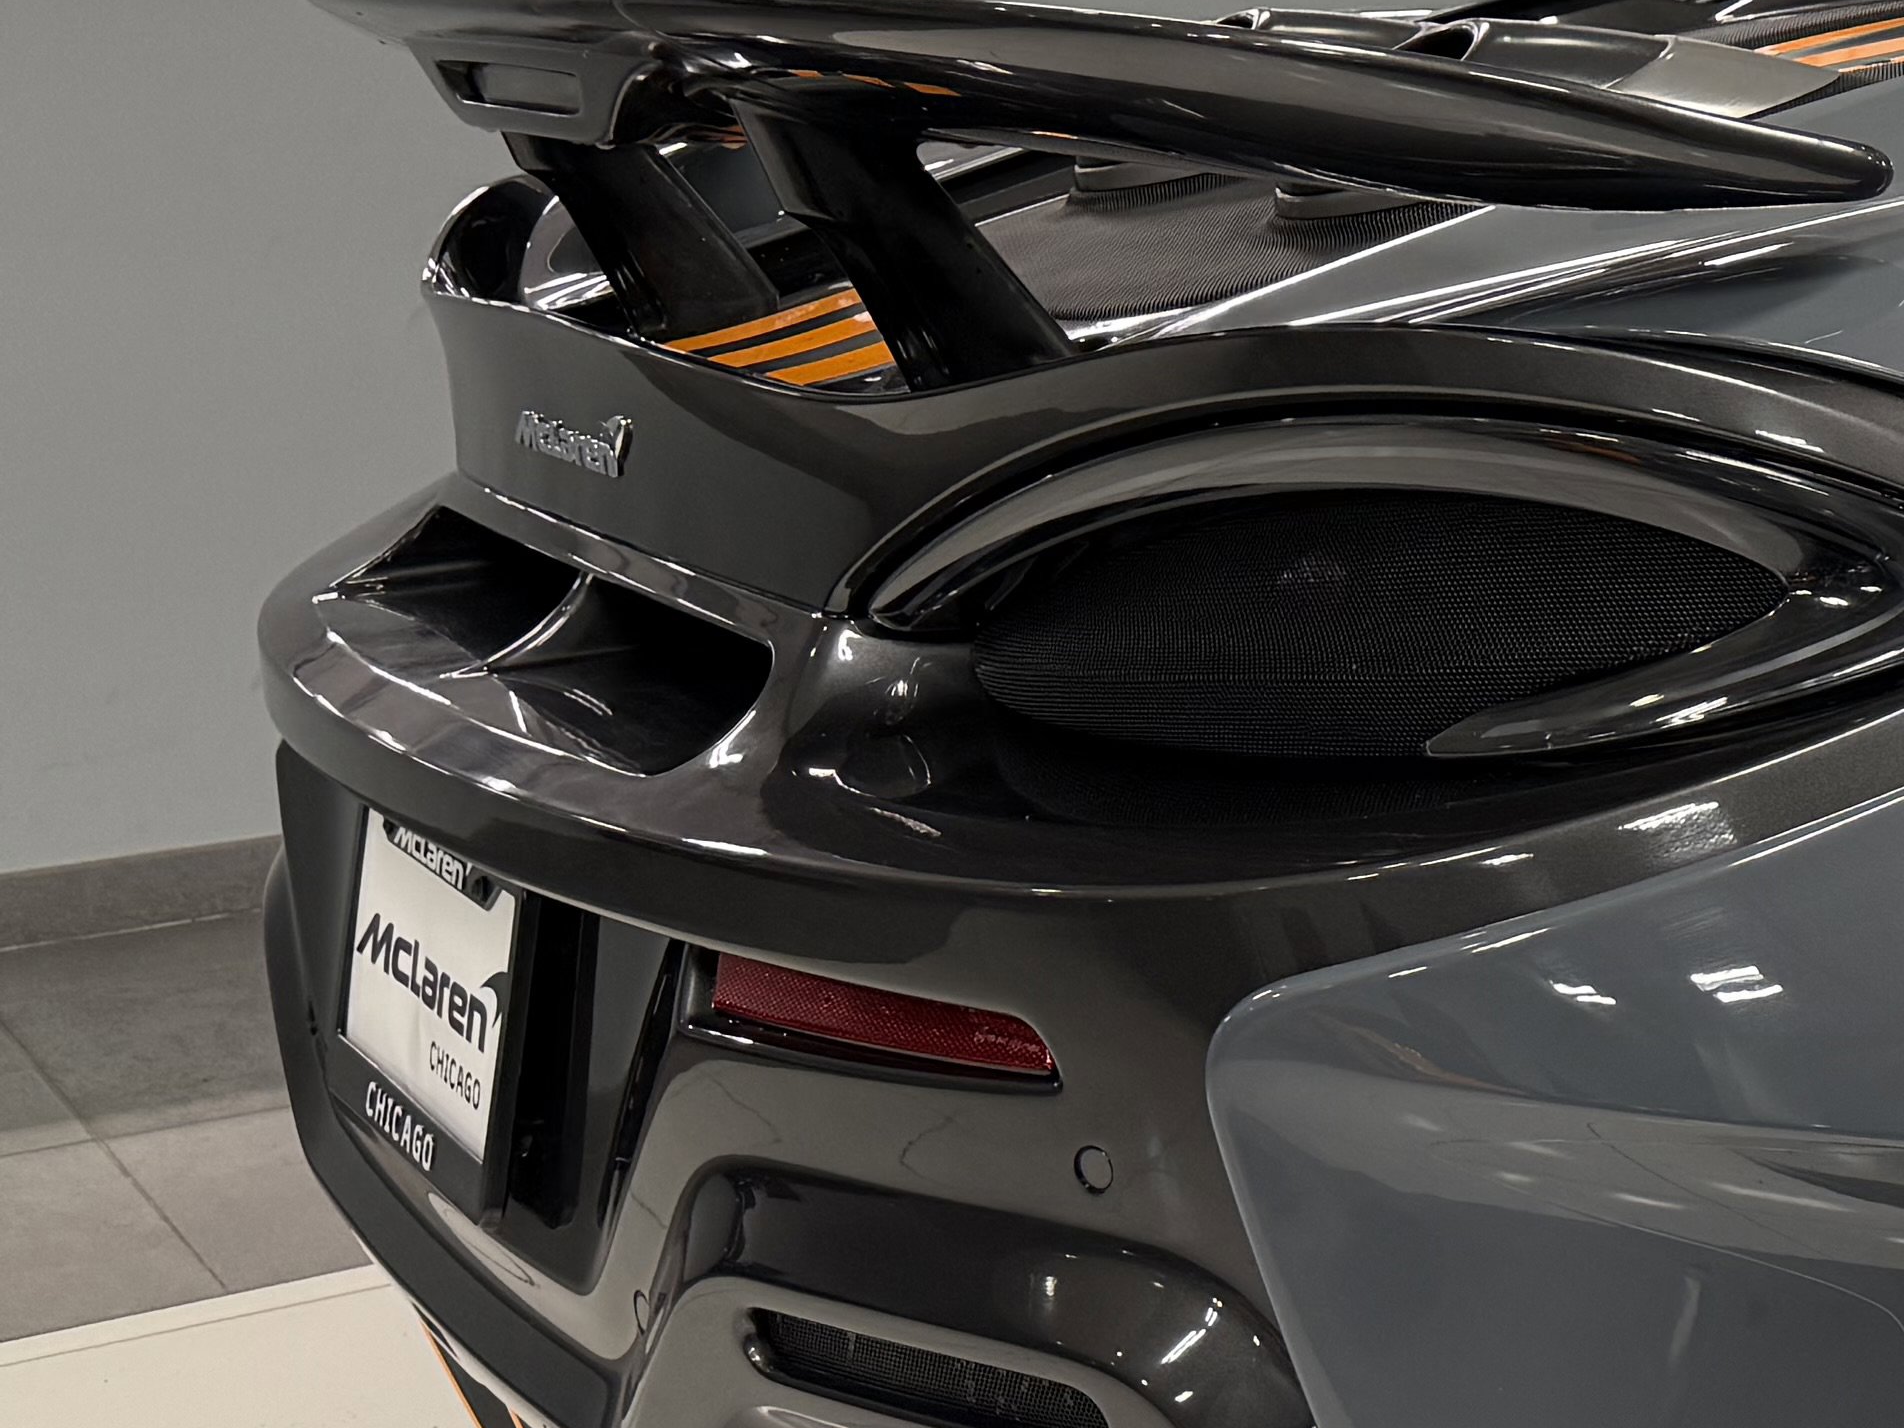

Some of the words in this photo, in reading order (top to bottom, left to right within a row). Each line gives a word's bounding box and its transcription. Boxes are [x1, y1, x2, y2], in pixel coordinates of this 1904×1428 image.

[515, 411, 619, 478] McLaren
[394, 826, 465, 890] McLaren
[356, 913, 488, 1054] McLaren
[429, 1040, 481, 1111] CHICAGO
[366, 1081, 434, 1172] CHICAGO
